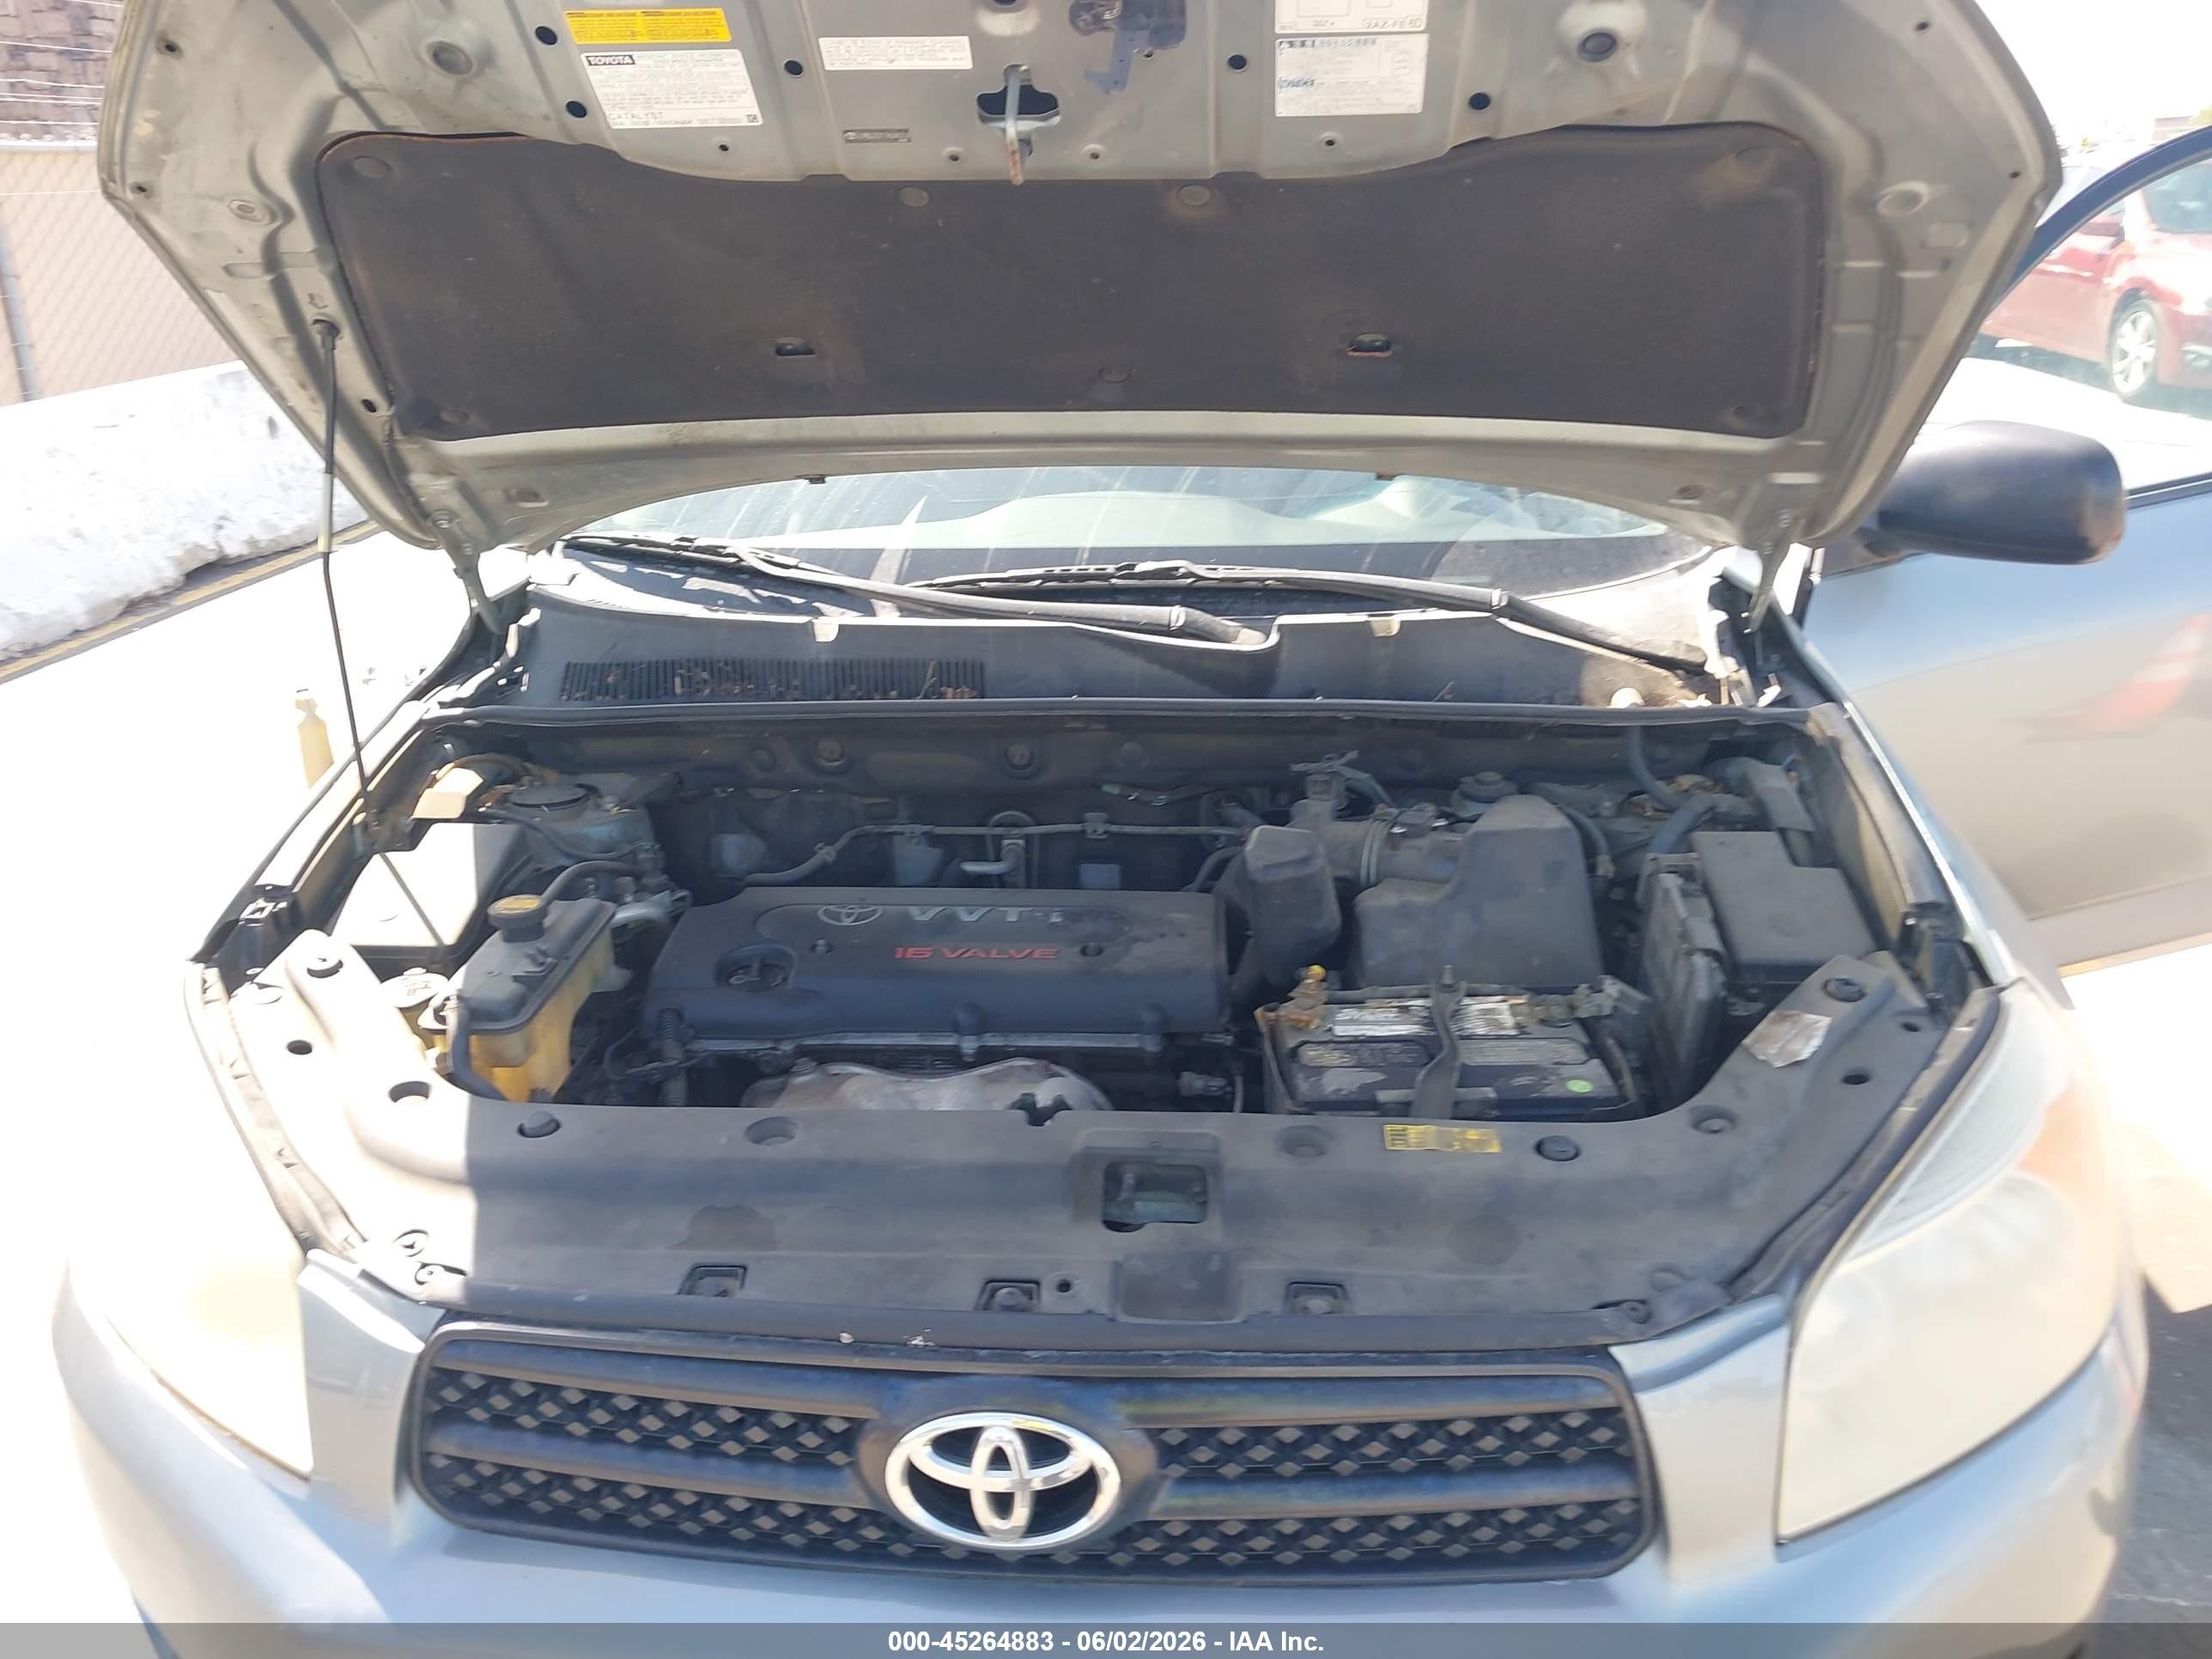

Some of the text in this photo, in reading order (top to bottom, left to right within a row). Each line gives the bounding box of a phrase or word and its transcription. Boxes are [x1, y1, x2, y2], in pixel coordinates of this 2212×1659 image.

[587, 56, 634, 65] TOYOTA
[895, 947, 1059, 959] 16 VALVE
